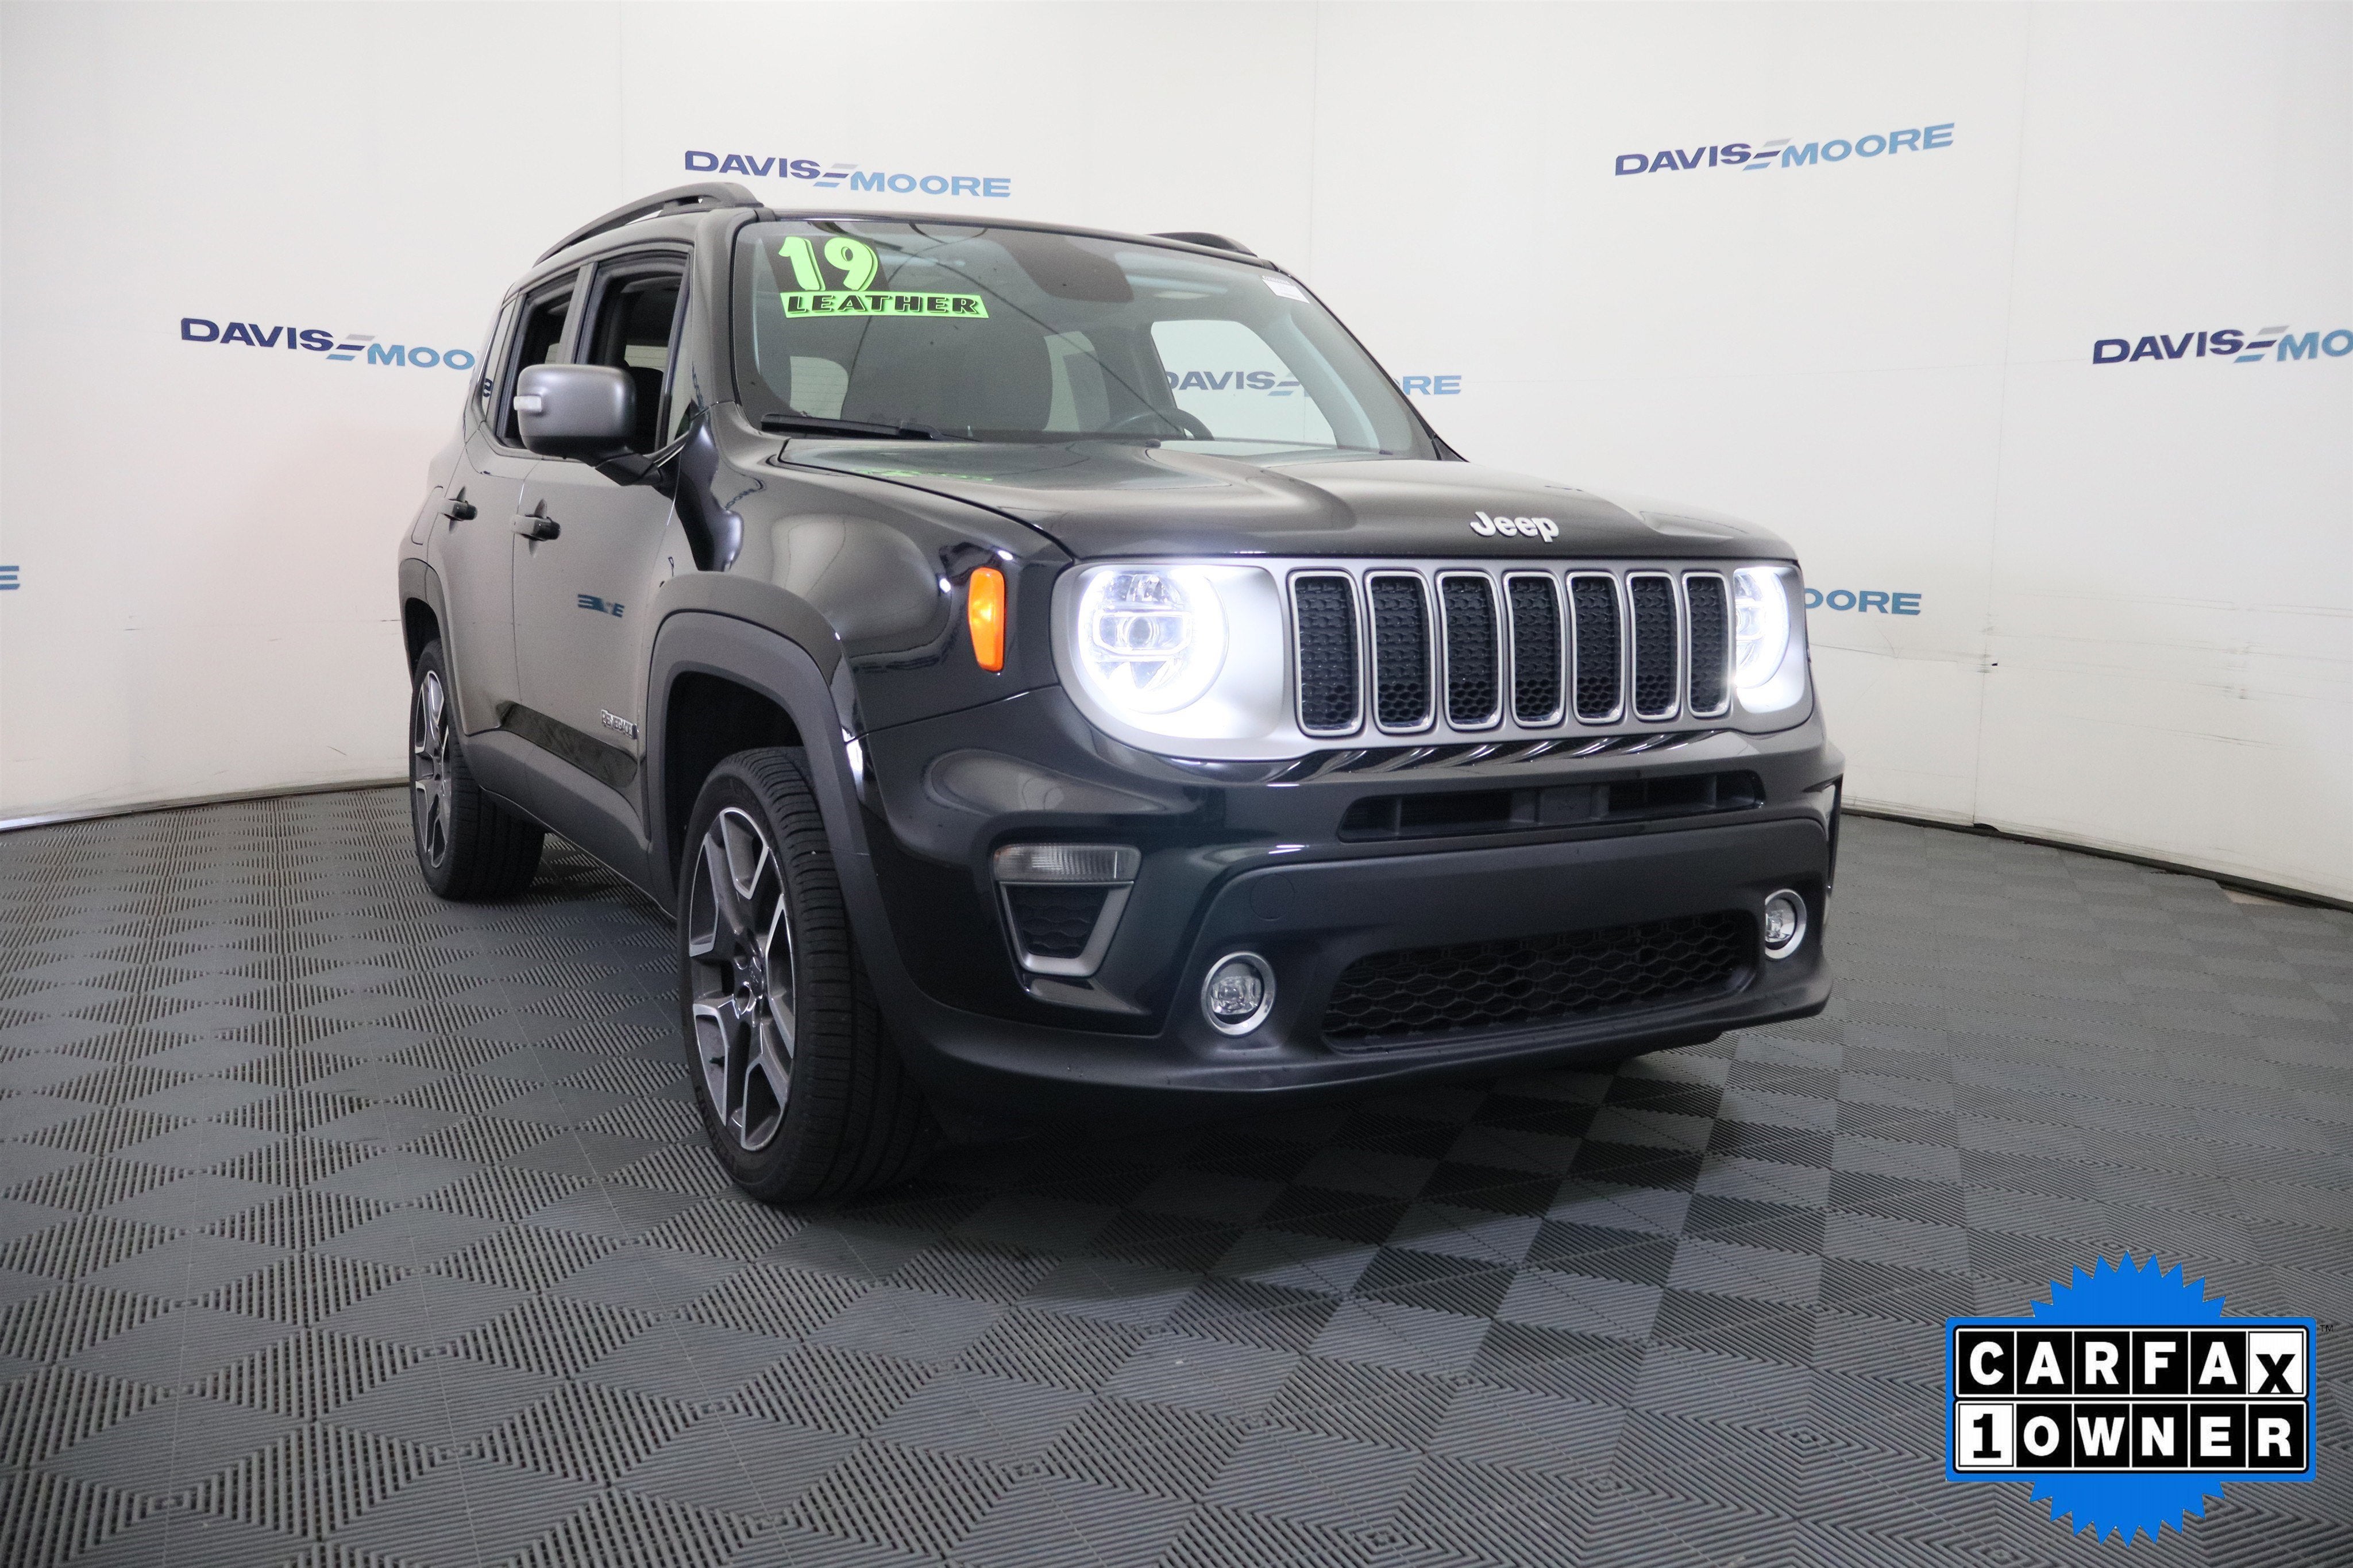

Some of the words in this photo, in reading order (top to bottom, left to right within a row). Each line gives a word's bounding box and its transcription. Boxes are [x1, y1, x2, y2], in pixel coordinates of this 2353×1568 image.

[1615, 143, 1752, 176] DAVIS
[1781, 122, 1955, 168] MOORE
[685, 150, 821, 179] DAVIS
[850, 171, 1011, 198] MOORE
[778, 235, 878, 291] 19
[788, 295, 978, 314] LEATHER
[180, 318, 334, 352] DAVIS
[367, 343, 475, 370] MOO
[2092, 329, 2245, 364] DAVIS
[1469, 511, 1559, 543] Jeep
[1804, 588, 1922, 616] OORE
